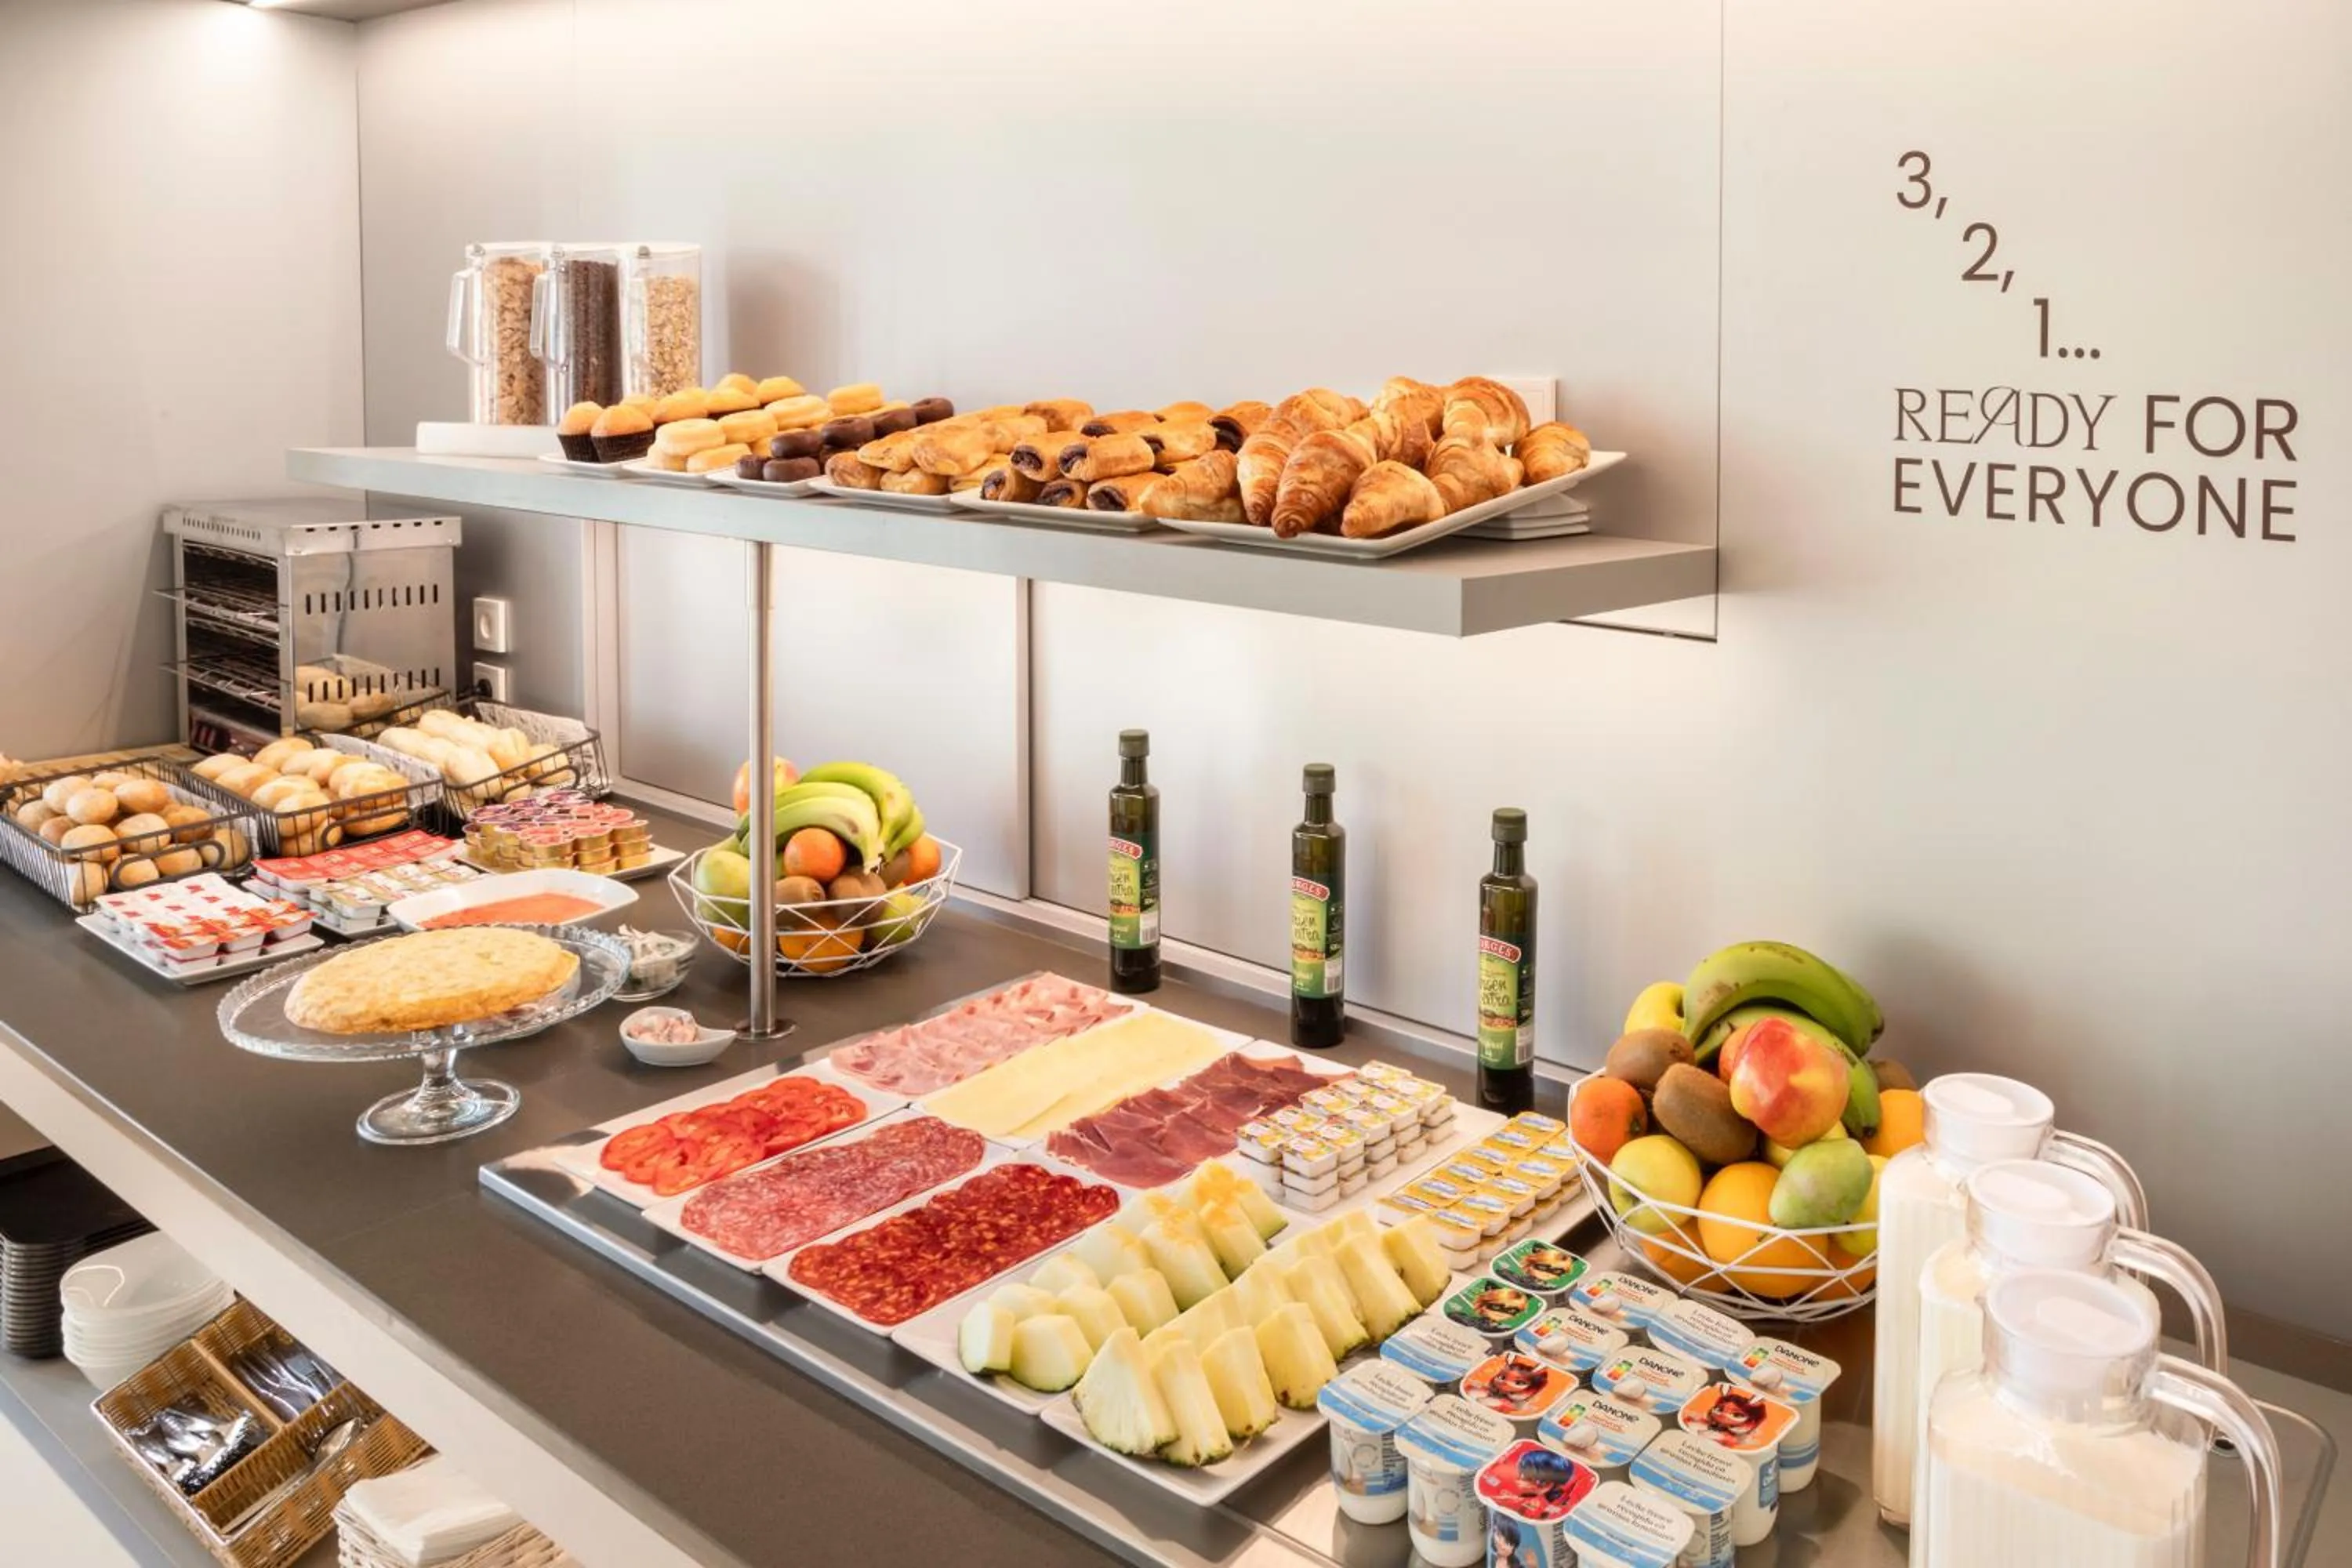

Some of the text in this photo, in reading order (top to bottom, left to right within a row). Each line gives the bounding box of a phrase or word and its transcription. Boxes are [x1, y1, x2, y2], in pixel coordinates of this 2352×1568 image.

[1896, 151, 1948, 219] 3,
[1962, 222, 2014, 292] 2,
[2033, 298, 2101, 358] 1...
[1893, 386, 2298, 461] READY FOR
[1893, 457, 2297, 543] EVERYONE
[1639, 1356, 1686, 1378] DANONE
[1774, 1345, 1820, 1368] DANONE
[1592, 1399, 1639, 1423] DANONE
